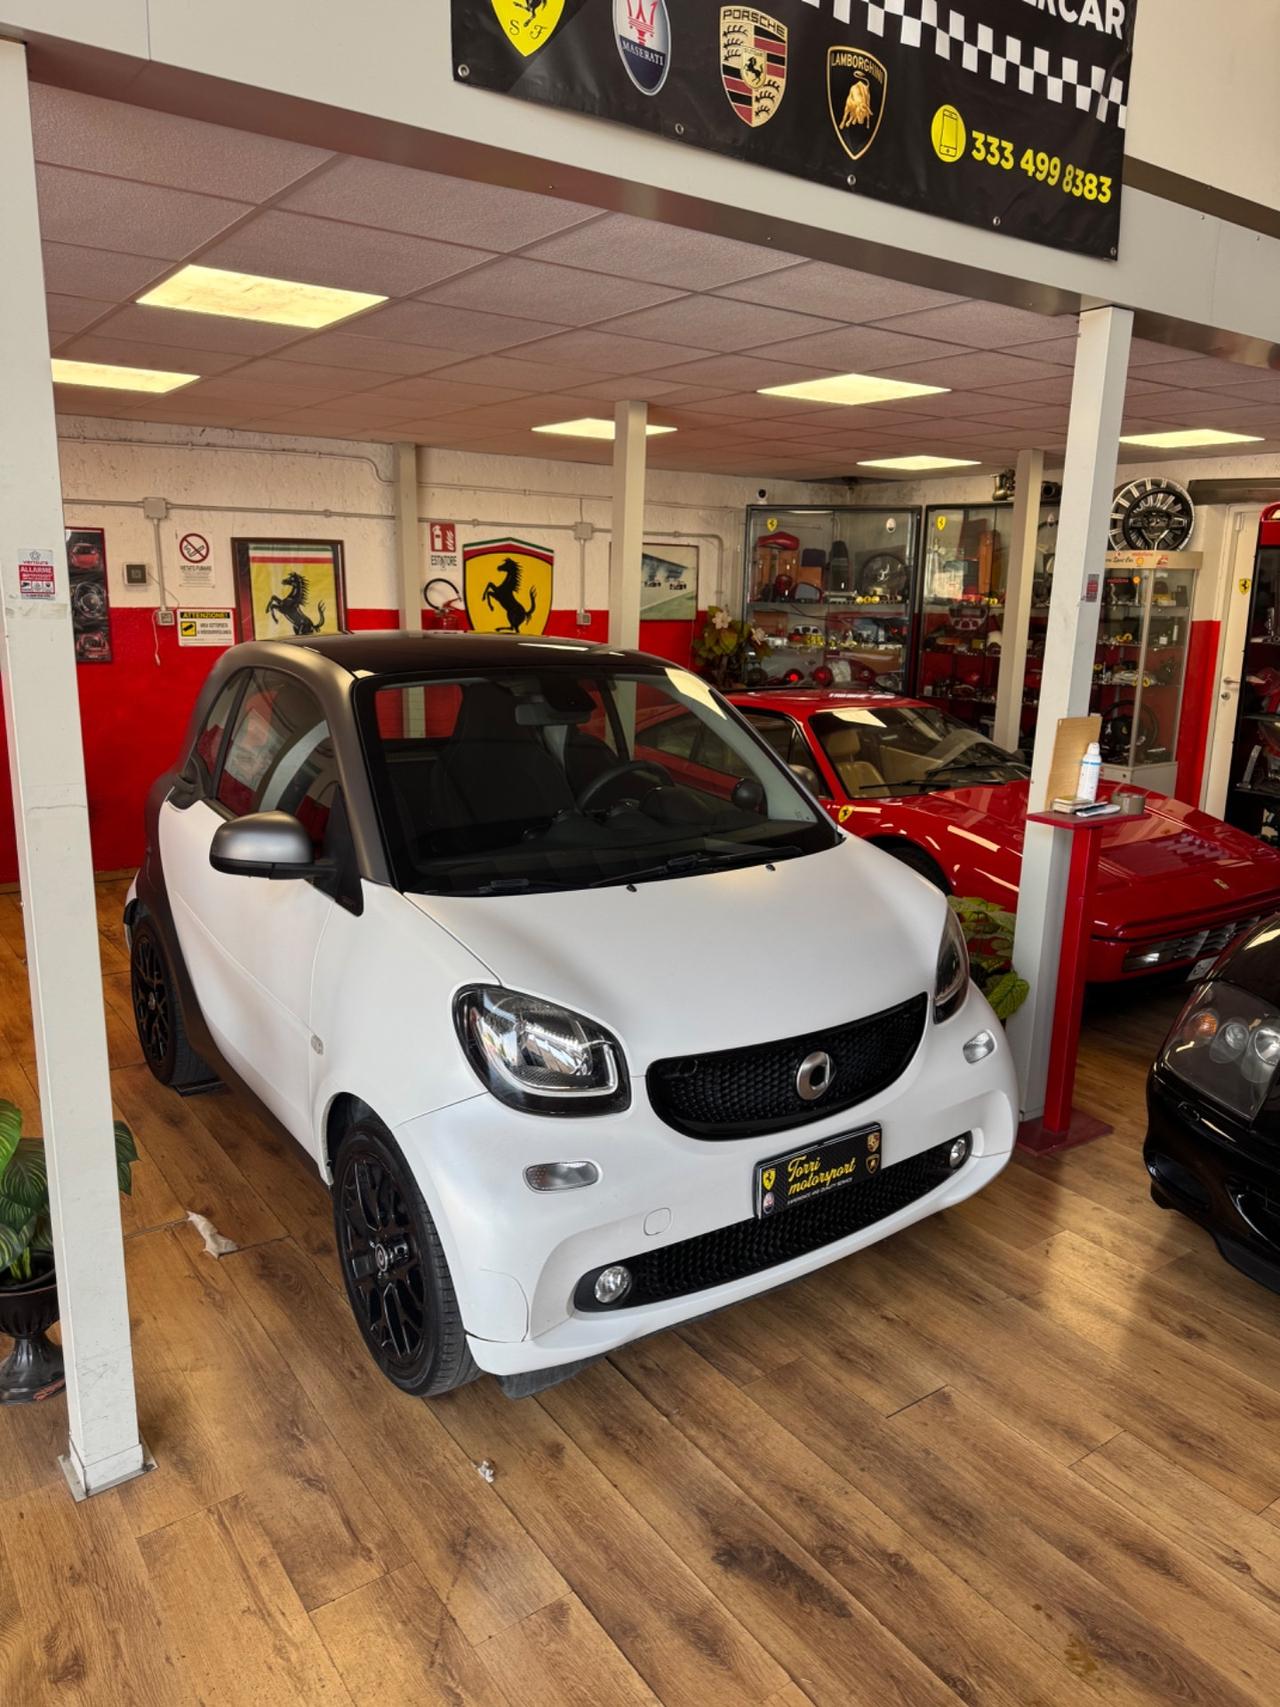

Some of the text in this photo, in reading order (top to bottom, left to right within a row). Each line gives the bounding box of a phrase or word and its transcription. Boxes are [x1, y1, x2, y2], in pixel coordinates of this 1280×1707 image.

[509, 19, 547, 40] S F
[722, 8, 786, 37] PORSCHE
[1022, 0, 1124, 40] CAR
[621, 39, 665, 67] MASERATI
[831, 52, 884, 84] LAMBORGHINI
[971, 130, 1112, 203] 333 499 8383
[788, 1157, 856, 1196] motorsport
